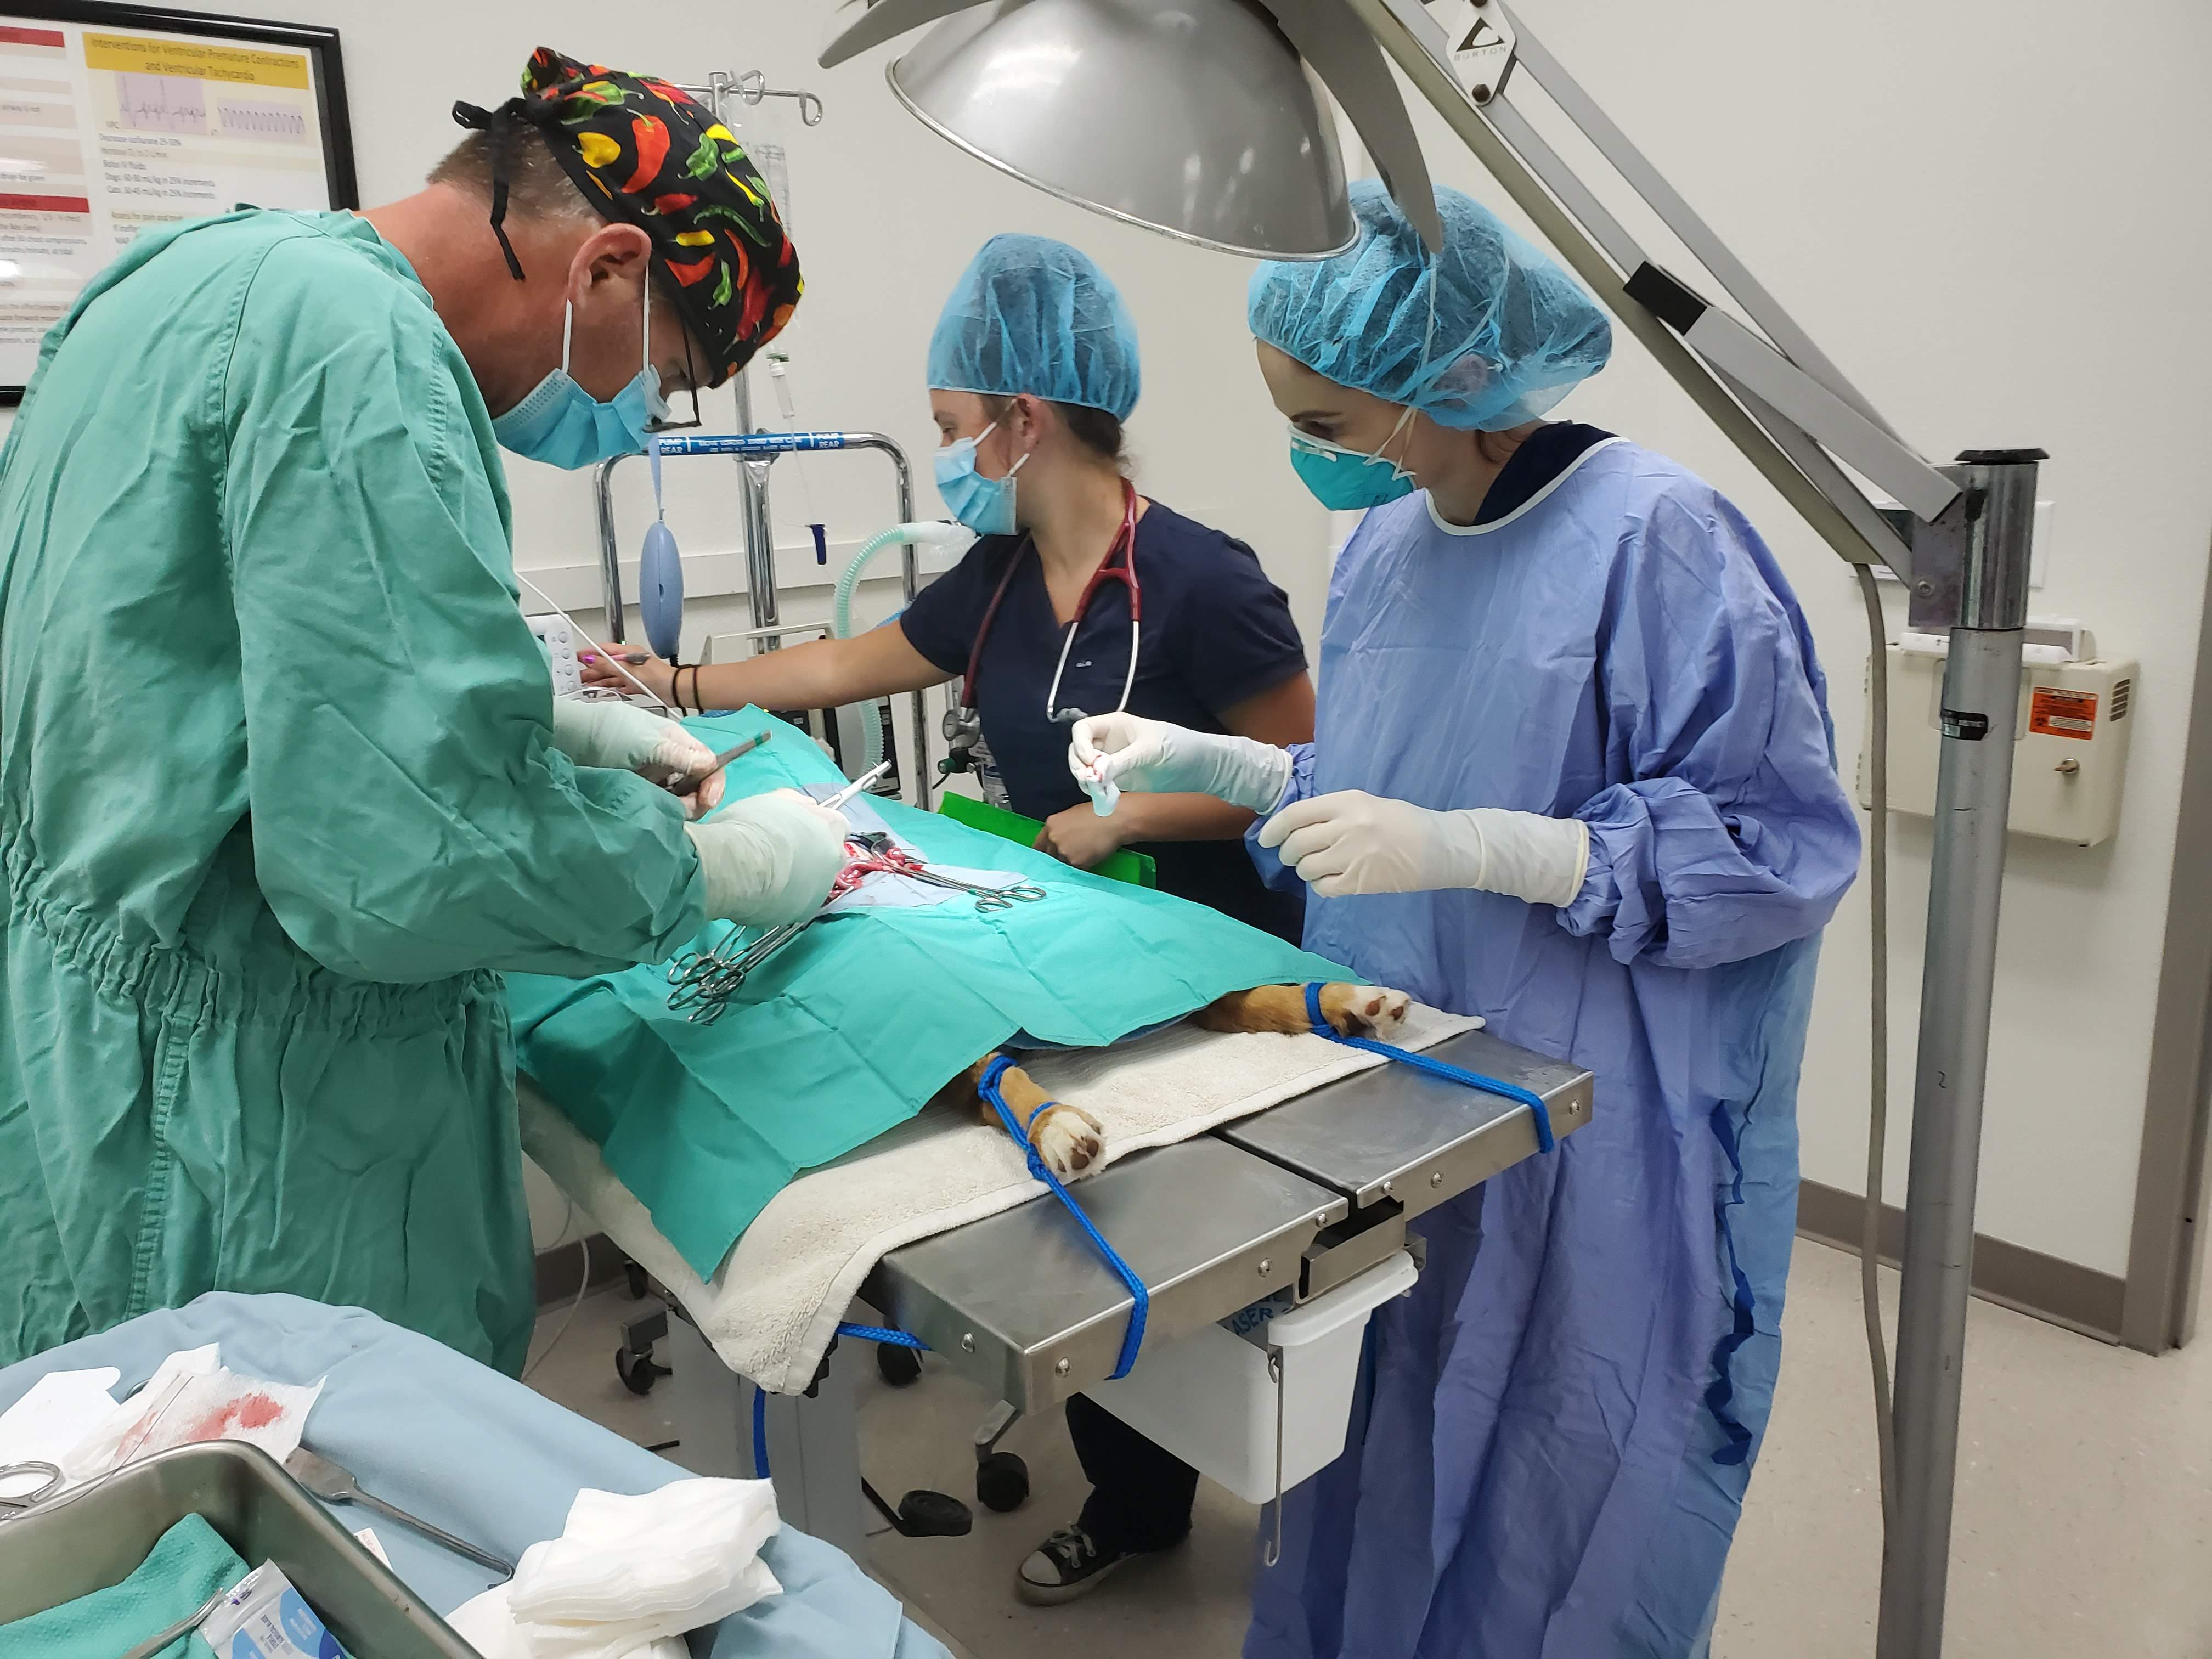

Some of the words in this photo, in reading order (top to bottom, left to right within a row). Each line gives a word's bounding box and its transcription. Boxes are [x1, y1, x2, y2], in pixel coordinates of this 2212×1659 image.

[92, 37, 146, 52] Interventions
[148, 42, 160, 53] for
[162, 45, 206, 58] Ventricular
[208, 49, 250, 63] Premature
[251, 54, 299, 69] Contractions
[1454, 46, 1506, 61] BURTON
[145, 61, 161, 71] and
[162, 62, 206, 75] Ventricular
[208, 66, 255, 81] Tachycardia
[1224, 1307, 1274, 1334] ASER
